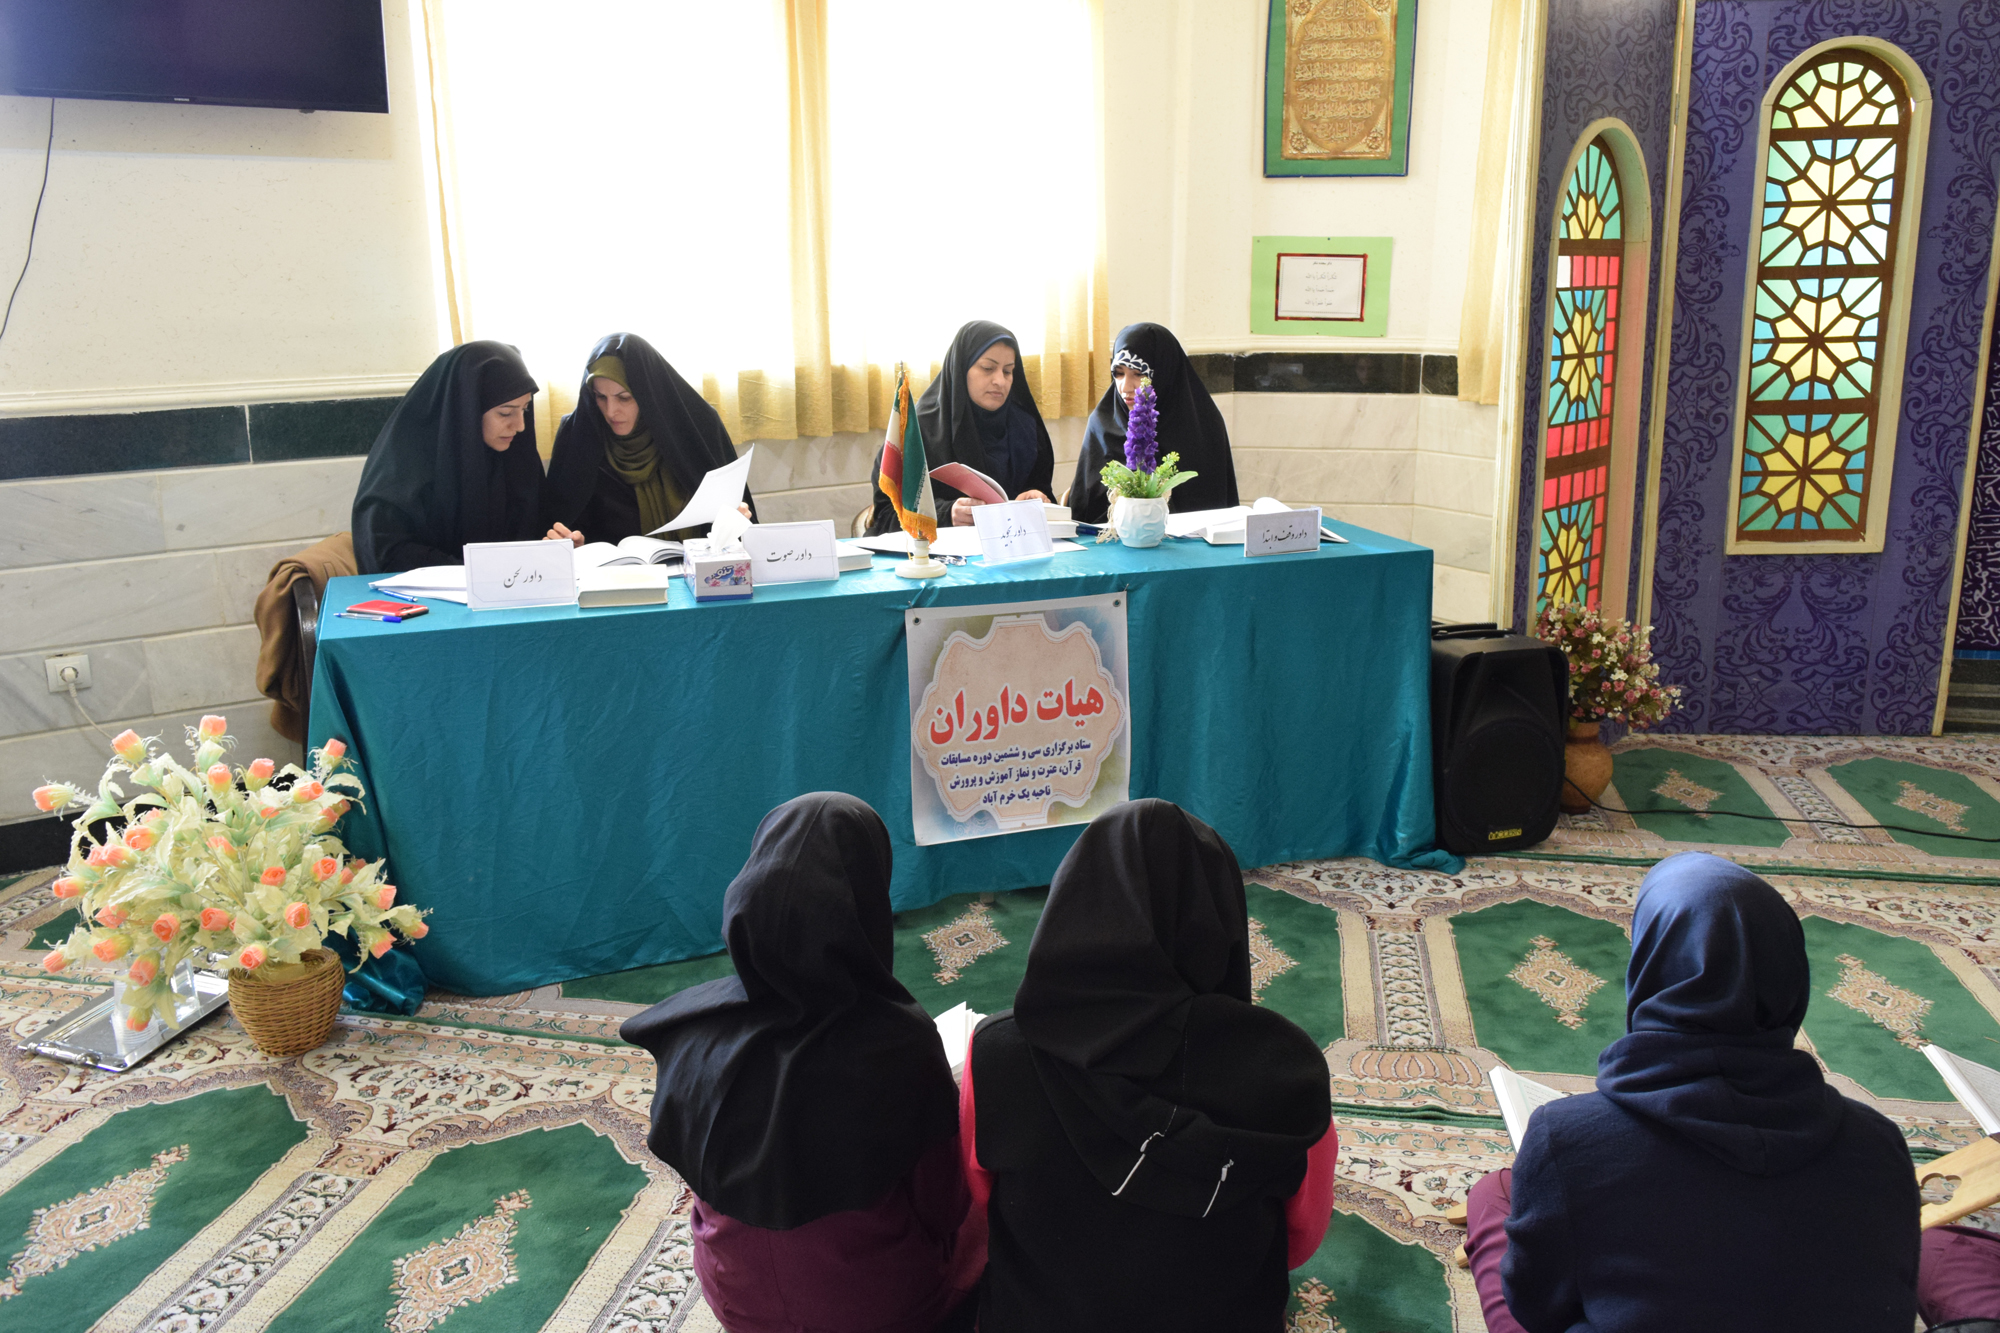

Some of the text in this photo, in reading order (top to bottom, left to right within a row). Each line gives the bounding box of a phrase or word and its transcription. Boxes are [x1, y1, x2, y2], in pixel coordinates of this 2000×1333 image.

[1013, 525, 1027, 537] داور
[1294, 529, 1307, 540] داور
[766, 548, 812, 563] داور صوت
[522, 569, 543, 584] داور
[930, 679, 1104, 745] هیات داوران
[940, 738, 1091, 767] ستاد برگزاری سی و ششمین دوره مسابقات
[984, 767, 1013, 785] آموزش
[1015, 767, 1030, 782] نماز
[1032, 769, 1036, 779] و
[1037, 764, 1057, 778] عترت
[949, 774, 977, 789] پرورش
[978, 776, 983, 786] و
[982, 785, 1051, 806] ناحیه یک خرم آباد
